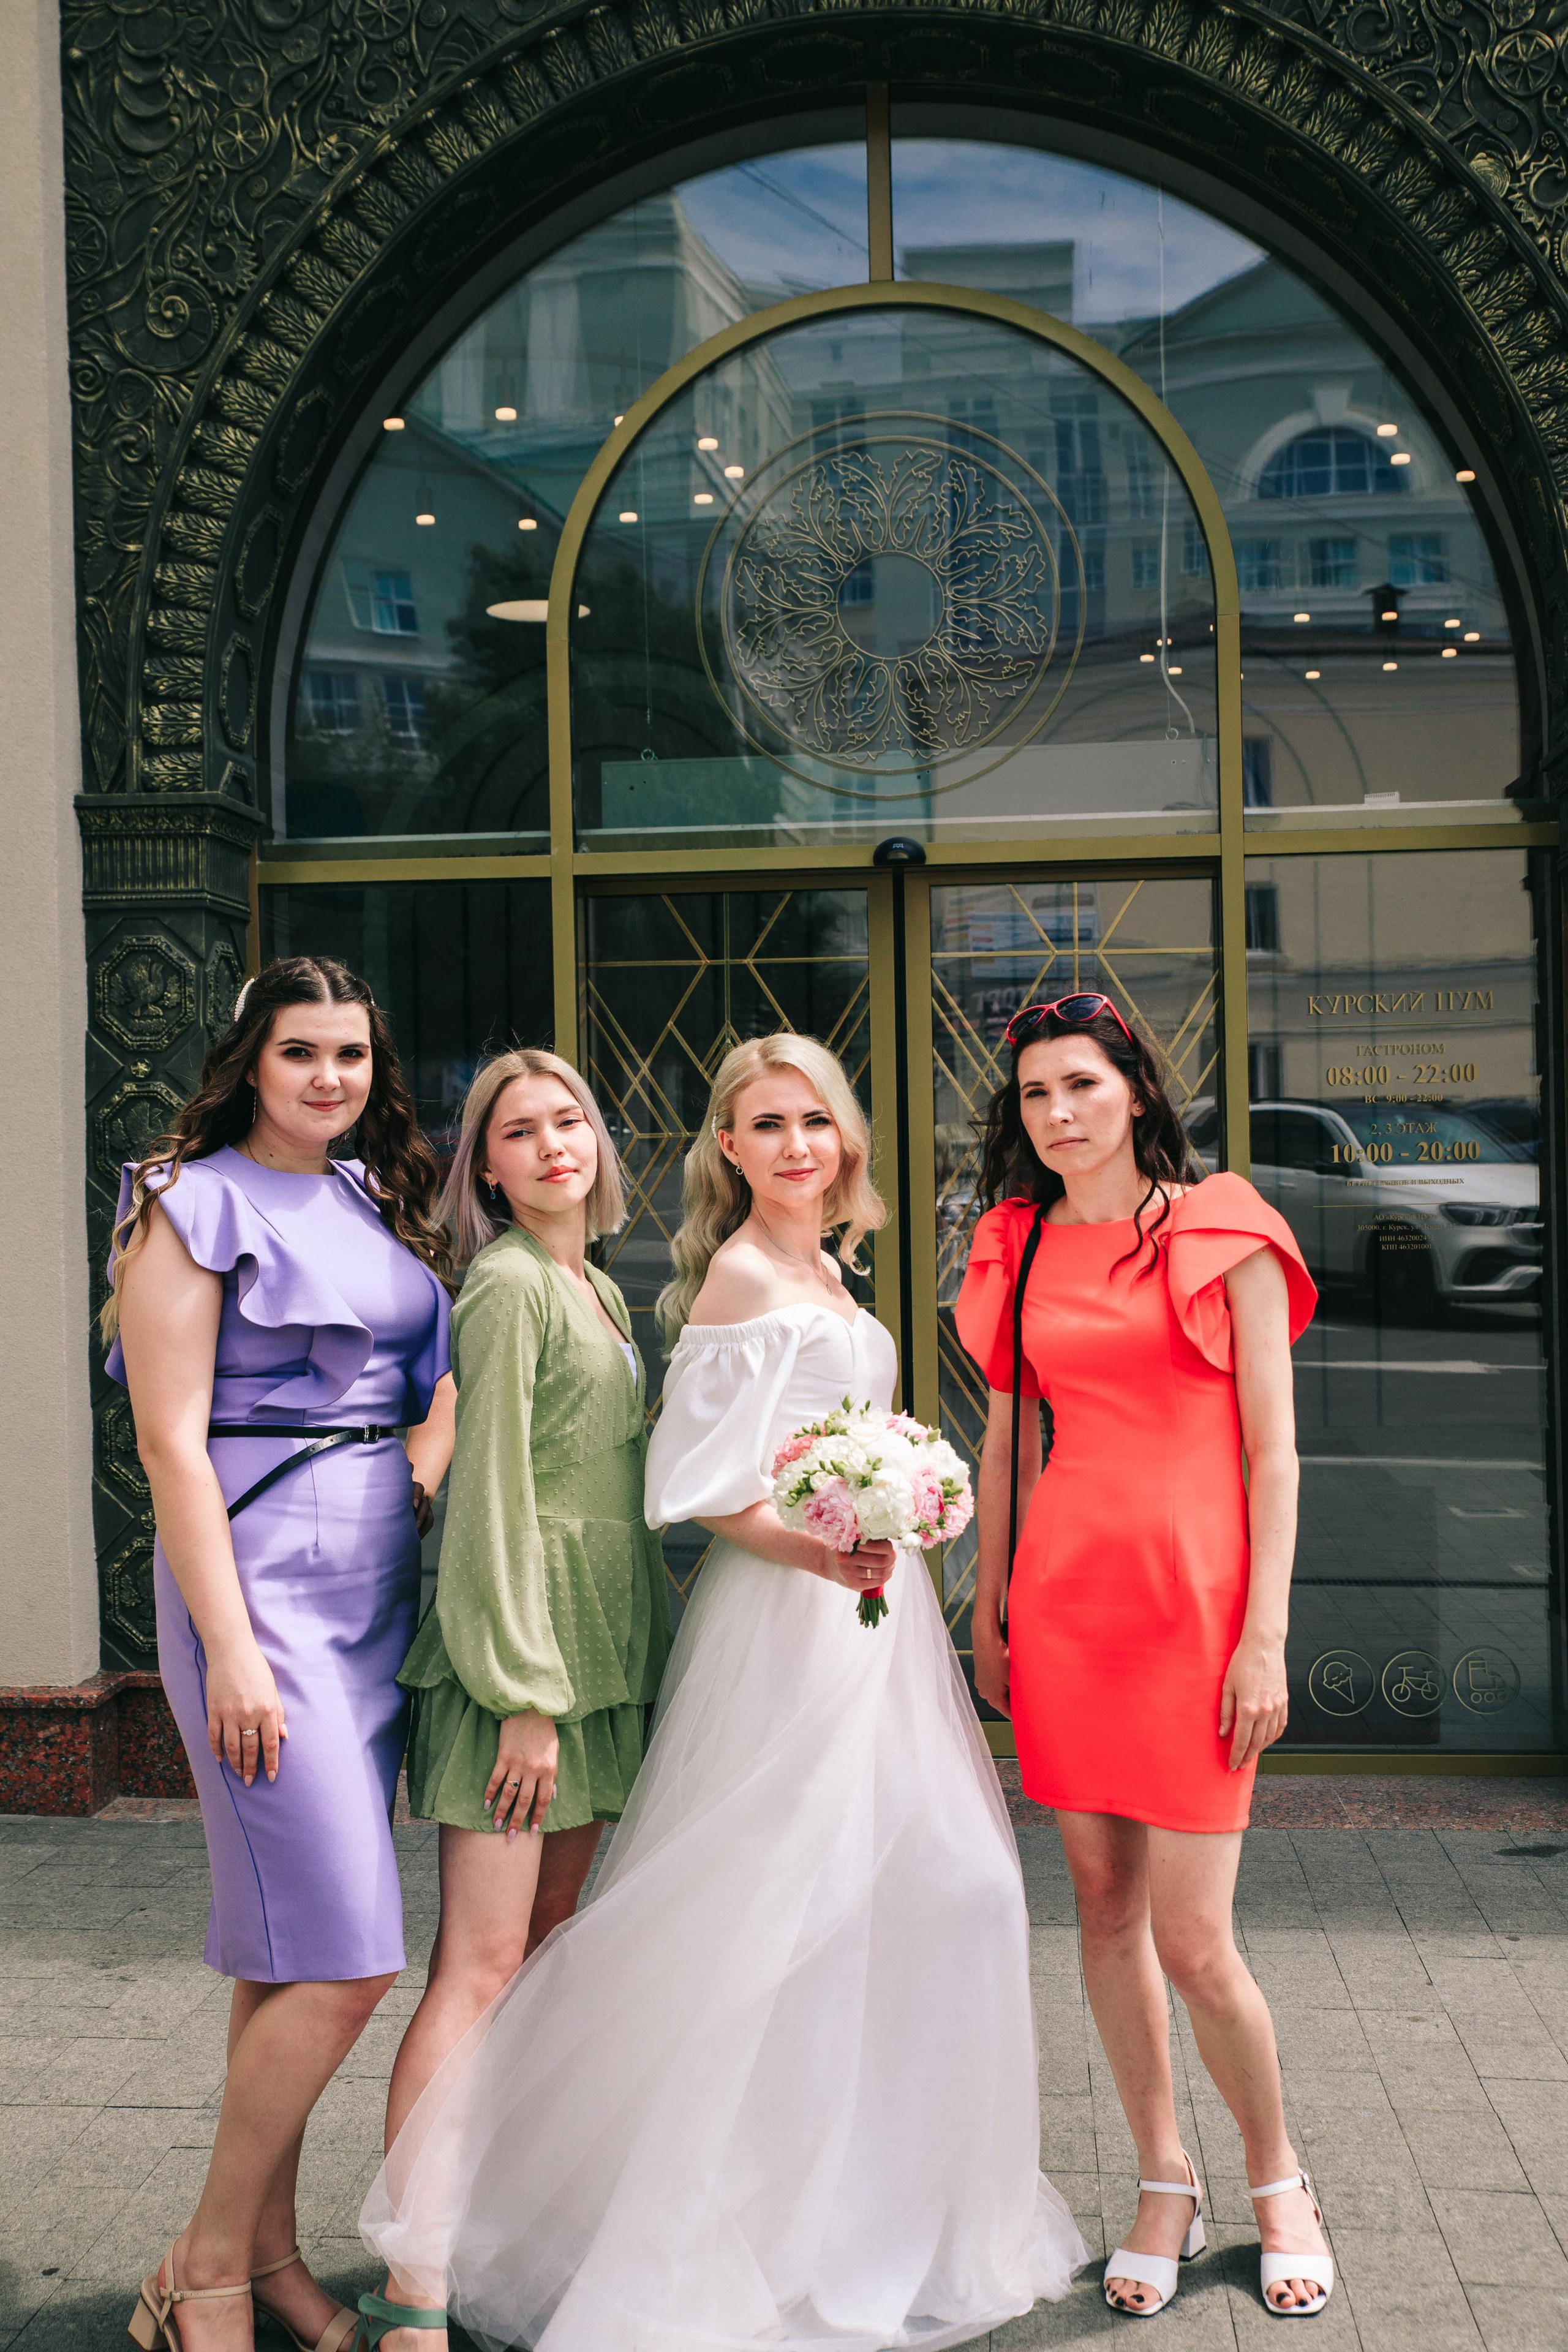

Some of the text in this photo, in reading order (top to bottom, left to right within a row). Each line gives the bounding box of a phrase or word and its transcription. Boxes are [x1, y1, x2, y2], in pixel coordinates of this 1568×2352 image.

[1307, 990, 1425, 1015] КУРСКИЙ
[1357, 1043, 1447, 1057] ГАСТРОНОМ
[1327, 1065, 1390, 1086] 08:00
[1413, 1063, 1478, 1084] 22:00
[1365, 1095, 1379, 1104] ВС
[1370, 1122, 1438, 1135] 2, 3 ЭТАЖ
[1330, 1142, 1393, 1163] 10:00
[1417, 1140, 1480, 1161] 20:00
